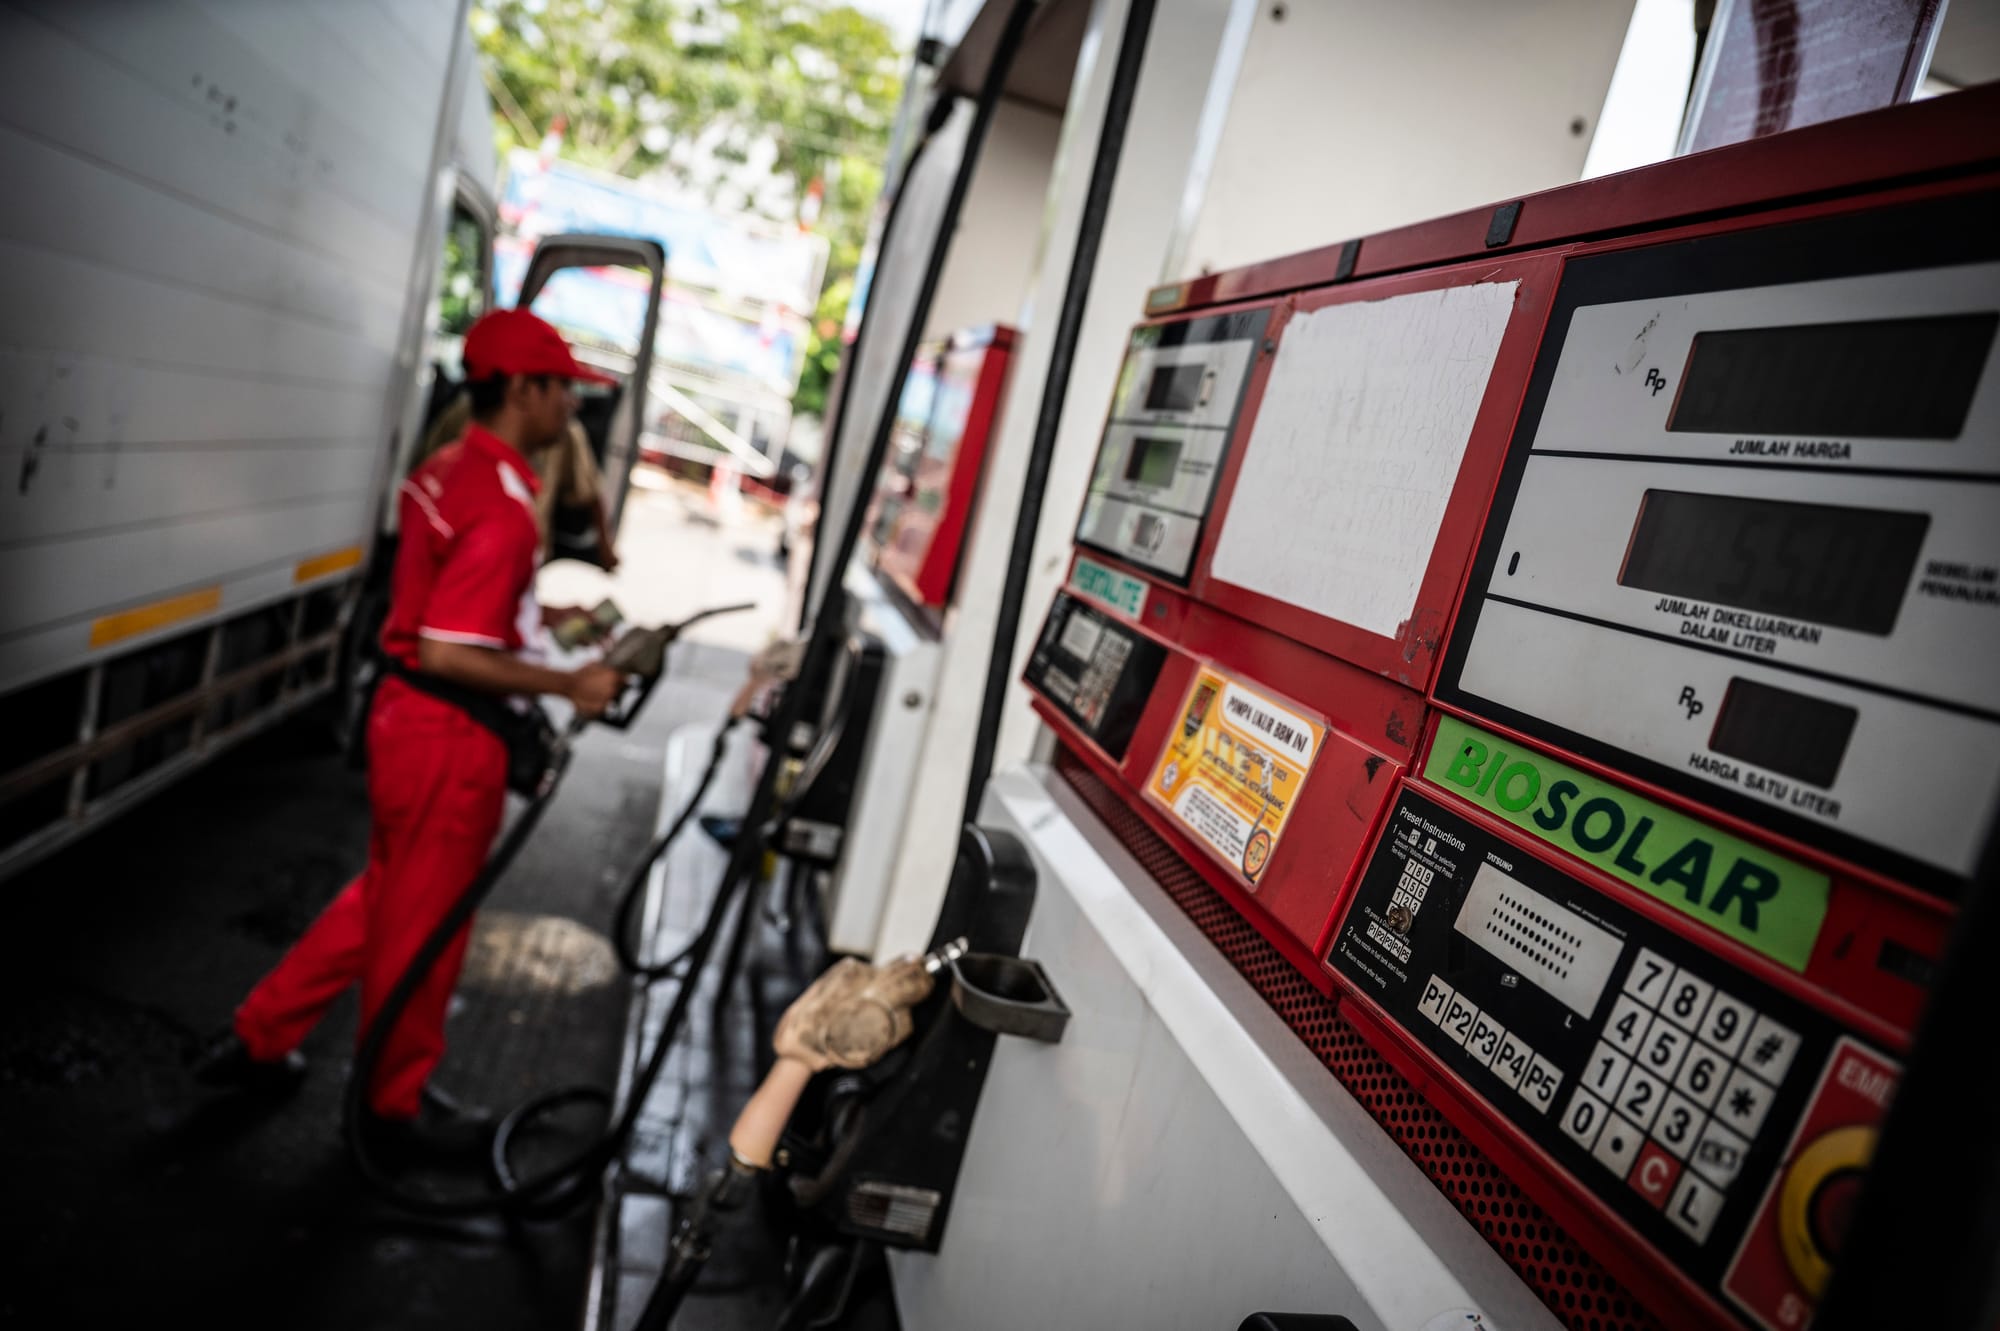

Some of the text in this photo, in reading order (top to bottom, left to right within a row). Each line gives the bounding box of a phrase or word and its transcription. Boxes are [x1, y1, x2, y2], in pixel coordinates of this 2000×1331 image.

[1728, 440, 1852, 459] JUMLAH HARGA
[1655, 598, 1822, 644] JUMLAH DIKELUARKAN
[1680, 621, 1777, 654] DALAM LITER
[1273, 721, 1294, 745] BBM
[1688, 752, 1842, 820] HARGA SATU LITER
[1400, 806, 1466, 851] Preset Instructions
[1445, 737, 1780, 933] BIOSOLAR
[1486, 852, 1513, 872] TATSUNO
[1340, 942, 1347, 952] 3
[1347, 926, 1354, 936] 2
[1638, 960, 1664, 993] 7
[1673, 984, 1698, 1018] 8
[1712, 1007, 1739, 1042] 9
[1423, 983, 1556, 1101] P1 P2 P3 P4 P5
[1615, 1011, 1716, 1093] 4 5 6
[1597, 1057, 1691, 1144] 1 2 3
[1572, 1102, 1595, 1135] 0
[1641, 1157, 1669, 1193] C
[1679, 1186, 1699, 1228] L
